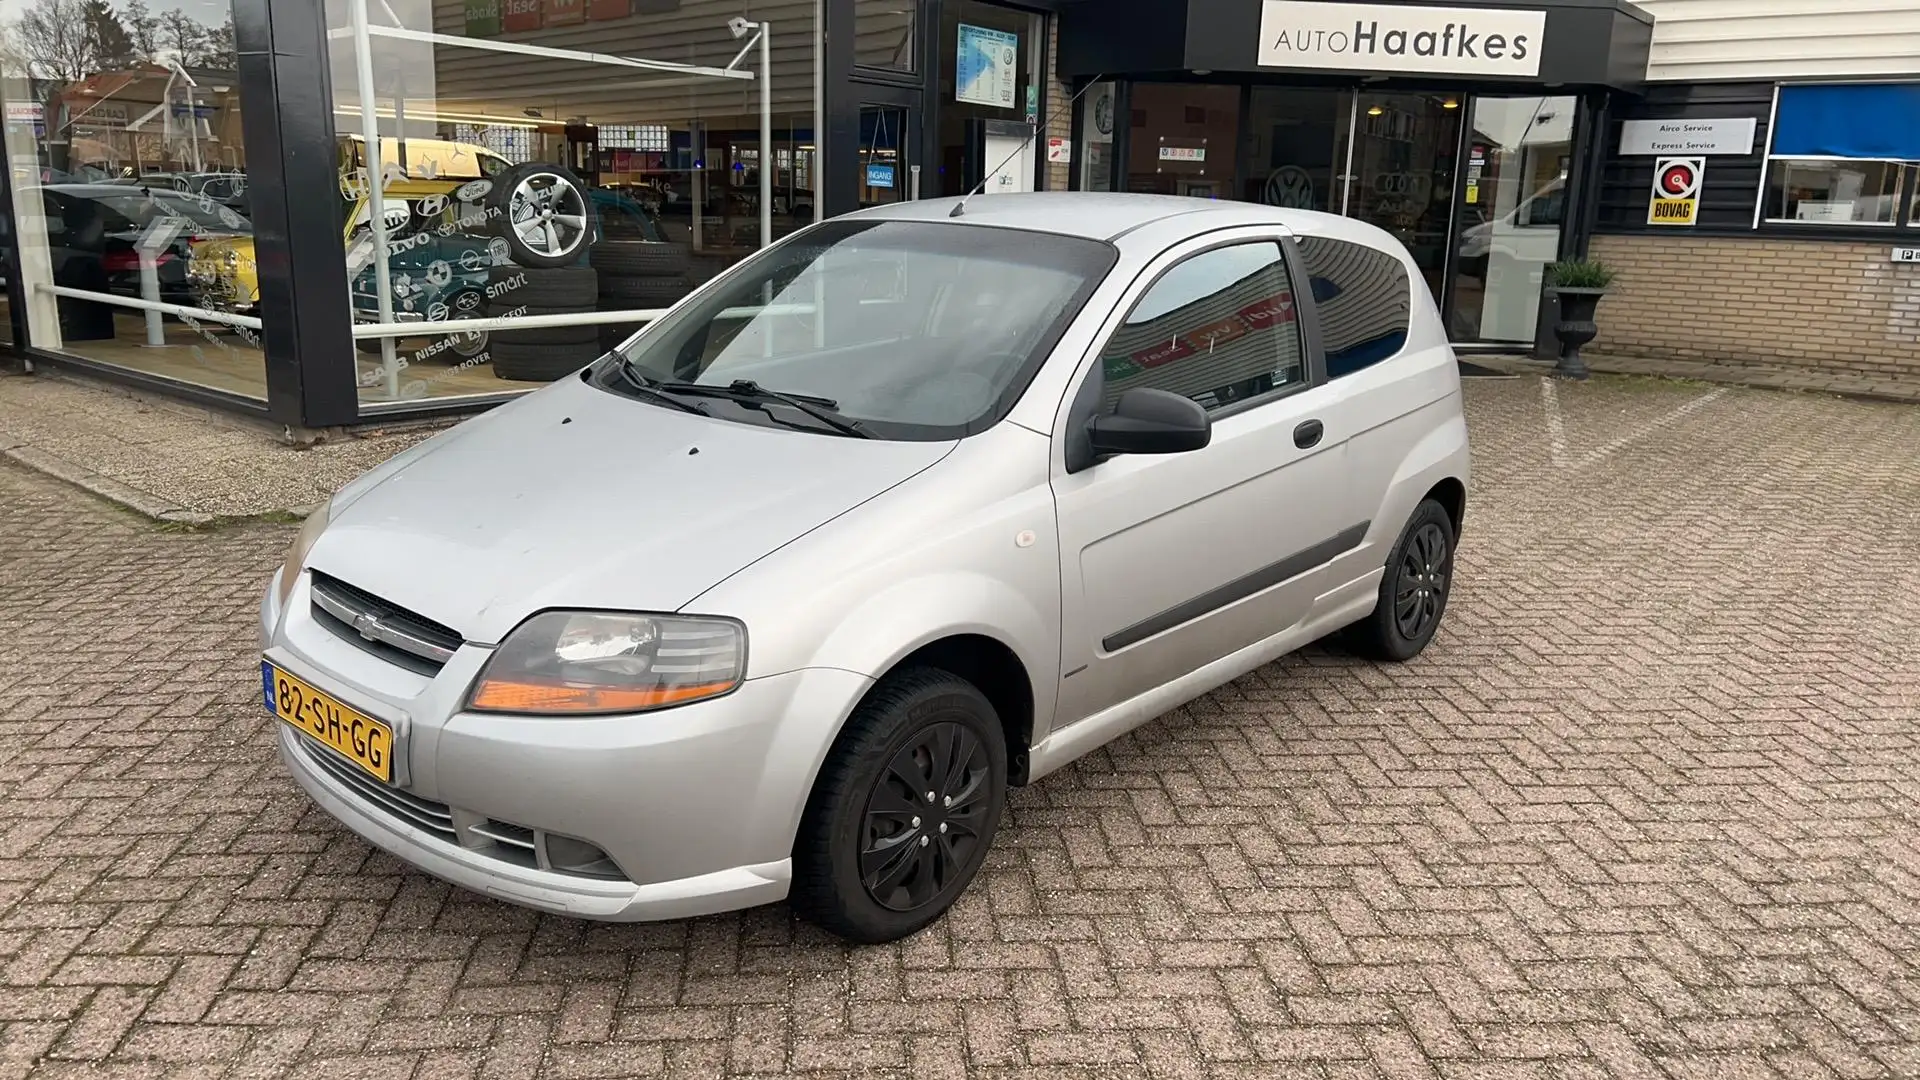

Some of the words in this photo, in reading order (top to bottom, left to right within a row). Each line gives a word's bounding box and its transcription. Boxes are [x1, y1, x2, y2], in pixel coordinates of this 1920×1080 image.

[1683, 124, 1713, 132] Service
[1651, 142, 1683, 150] Express
[1686, 141, 1716, 149] Service
[455, 207, 503, 230] TOYOTA
[1654, 202, 1690, 218] BOVAG
[485, 272, 529, 300] smart
[415, 334, 461, 361] NISSAN
[361, 356, 409, 385] SAB
[459, 351, 491, 371] ROVER
[279, 678, 382, 769] 82-SH-GG
